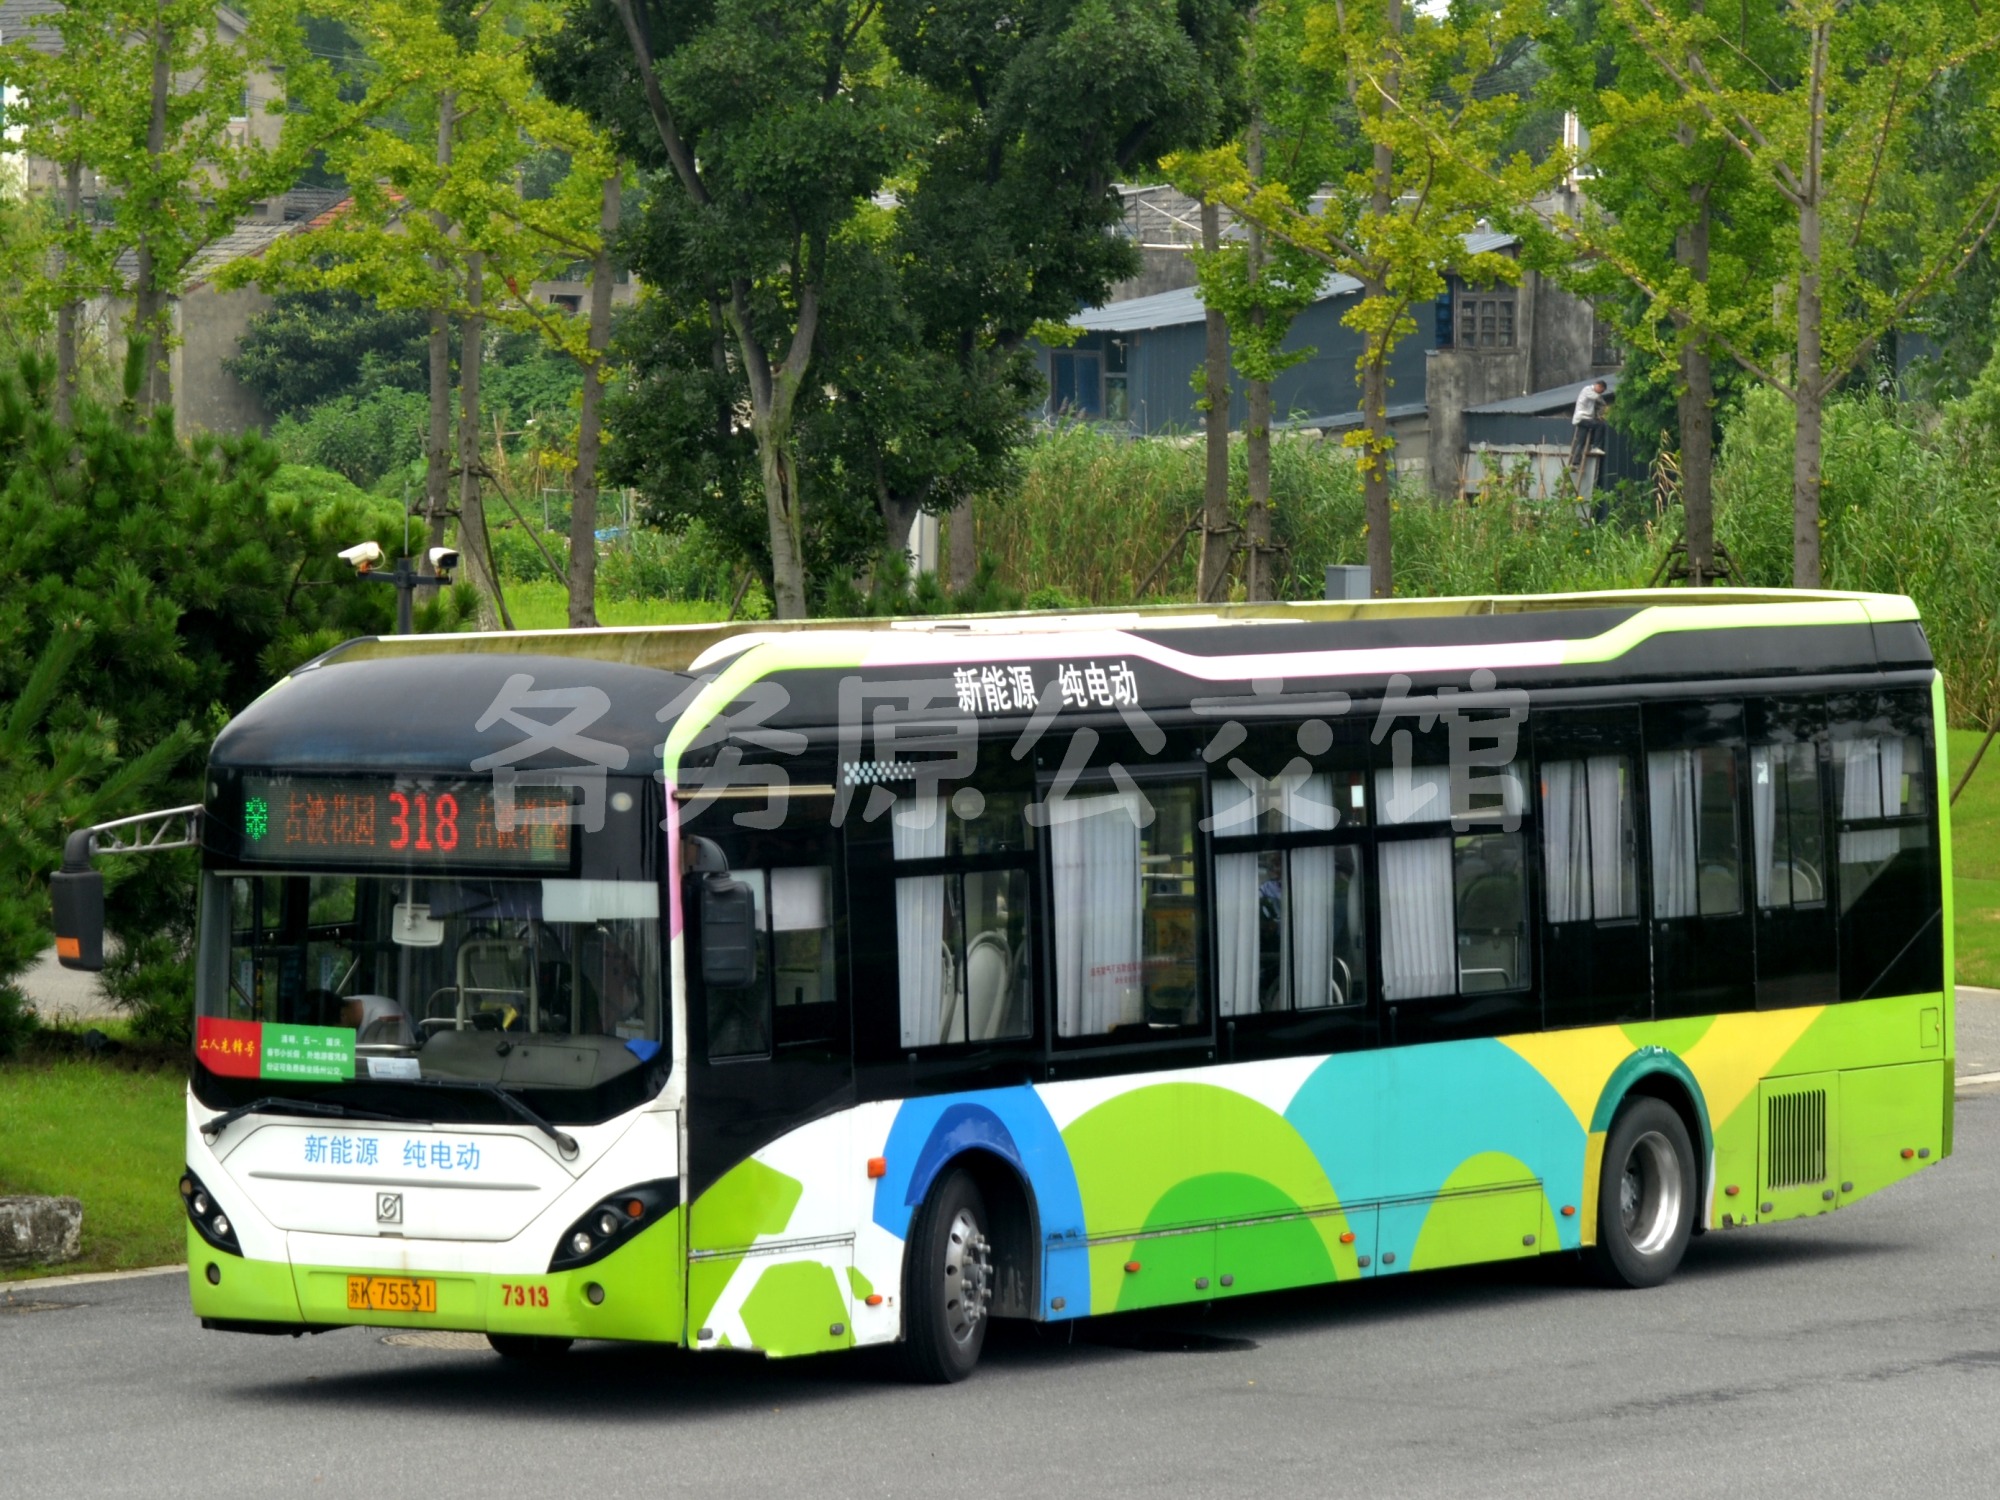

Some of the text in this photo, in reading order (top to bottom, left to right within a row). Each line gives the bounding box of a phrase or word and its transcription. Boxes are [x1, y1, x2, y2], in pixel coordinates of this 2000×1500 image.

[953, 660, 1139, 713] 新能源 纯电动
[388, 790, 460, 852] 318
[200, 1037, 255, 1058] 工人先锋号
[304, 1134, 480, 1171] 新能源 纯电动
[501, 1284, 549, 1308] 7313
